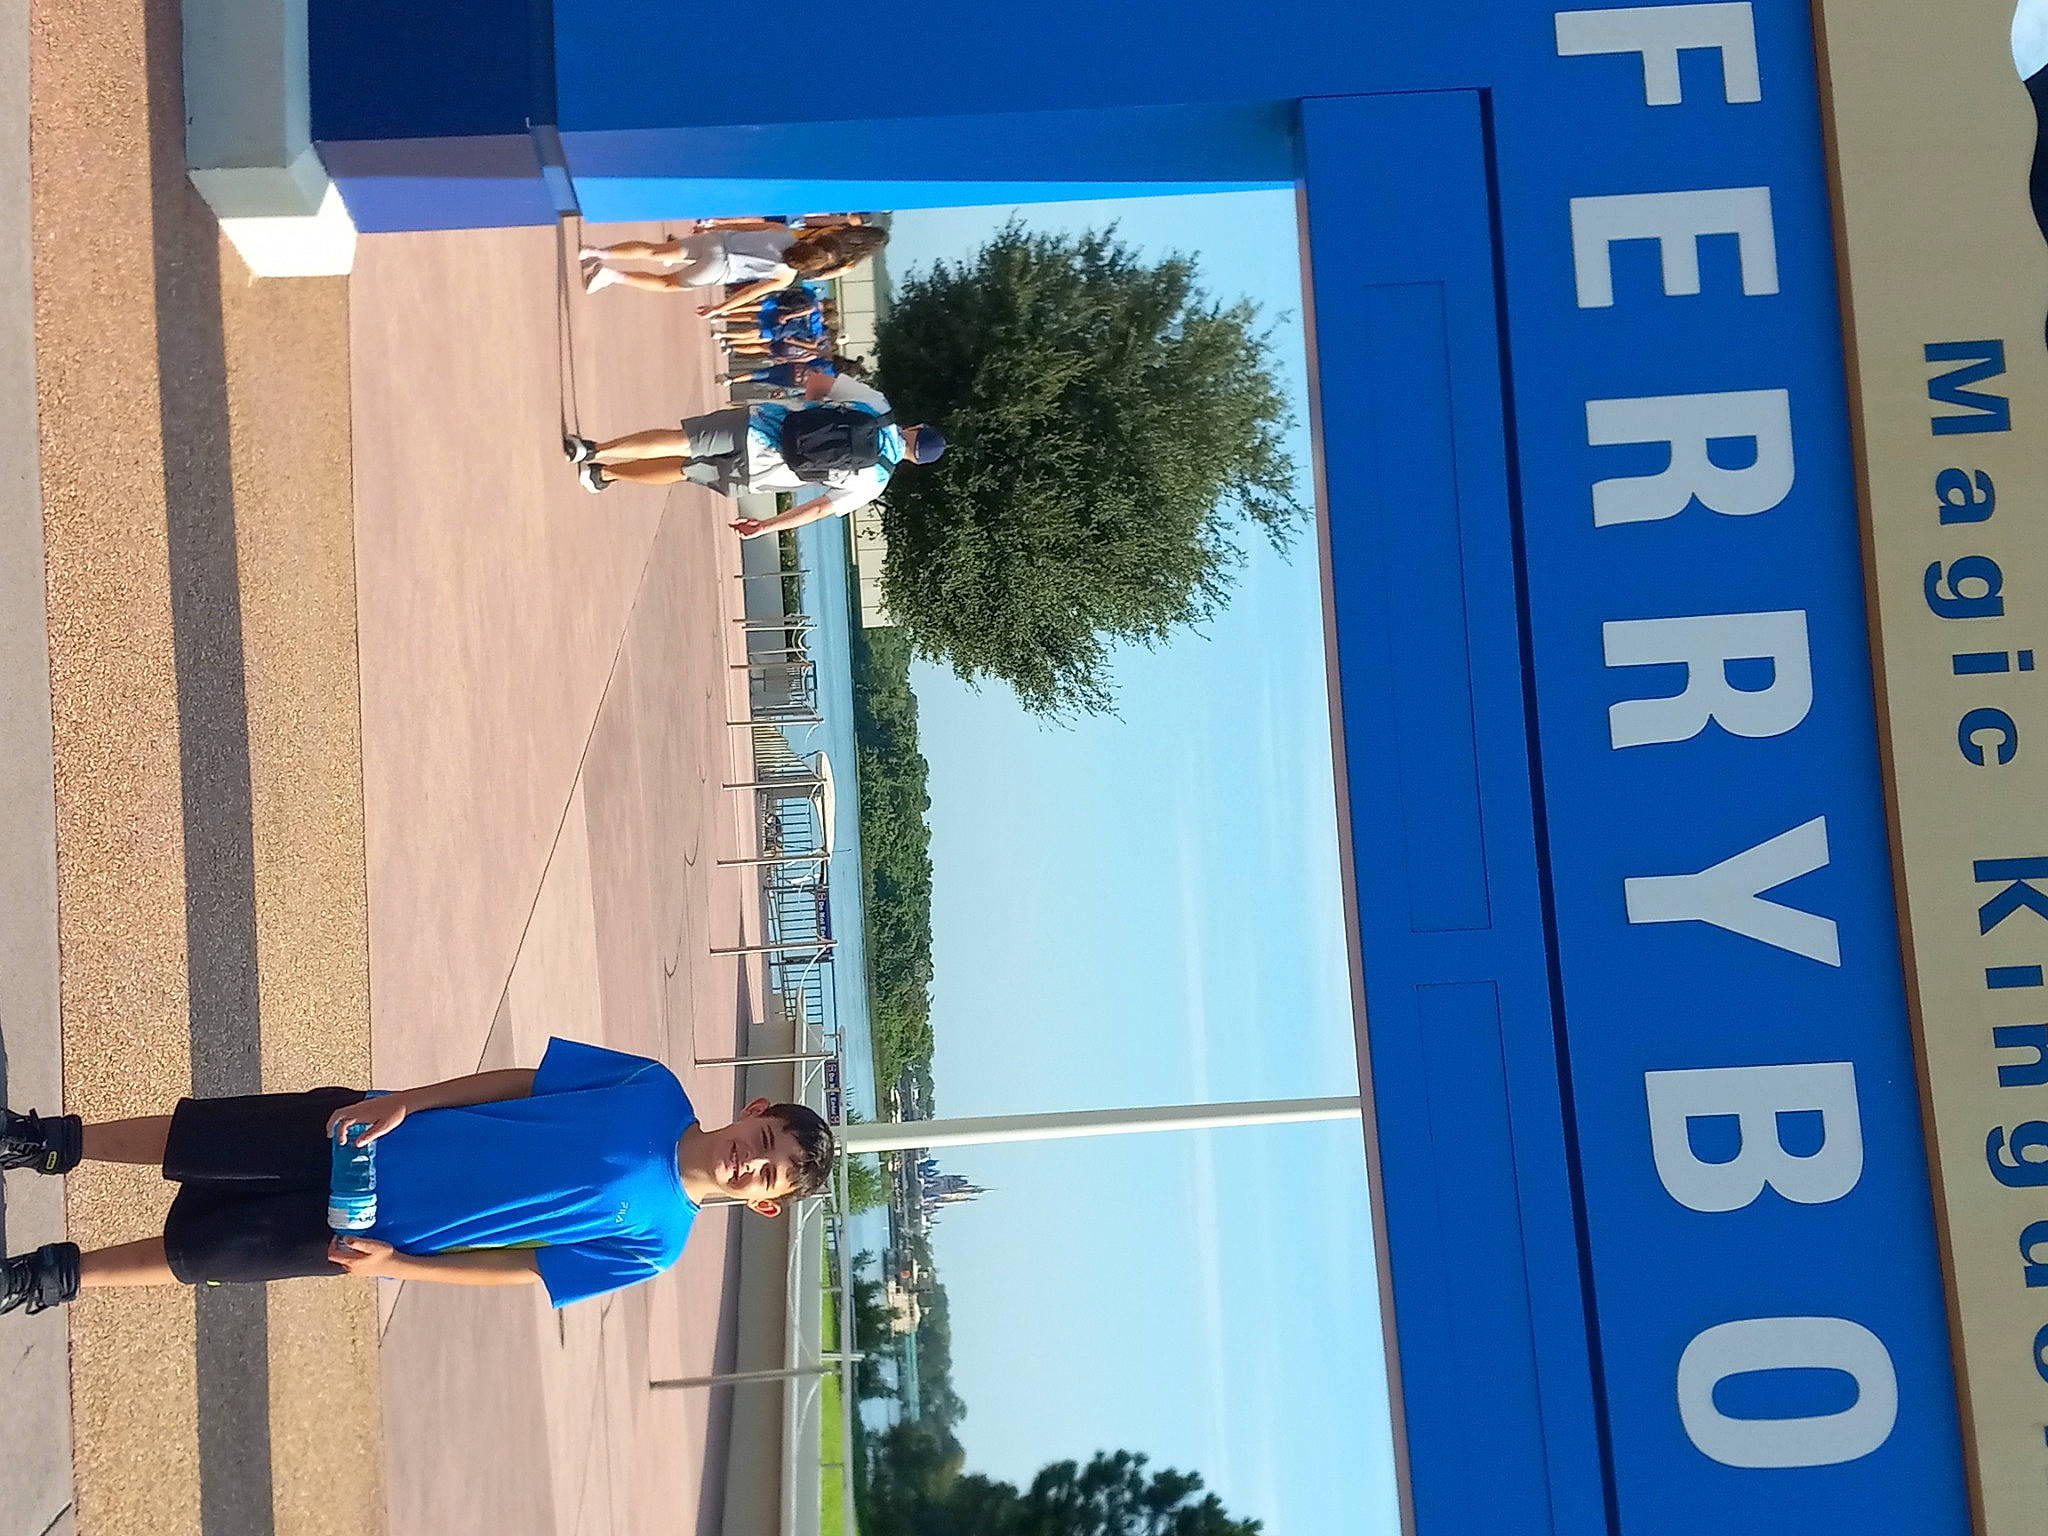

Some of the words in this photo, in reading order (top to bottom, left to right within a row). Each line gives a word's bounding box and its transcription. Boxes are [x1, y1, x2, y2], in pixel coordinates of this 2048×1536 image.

[1554, 1, 1899, 1469] FERRYBO
[1924, 338, 2035, 767] Magic
[818, 901, 824, 911] Do
[828, 1072, 834, 1082] Do
[1973, 856, 2048, 1462] King
